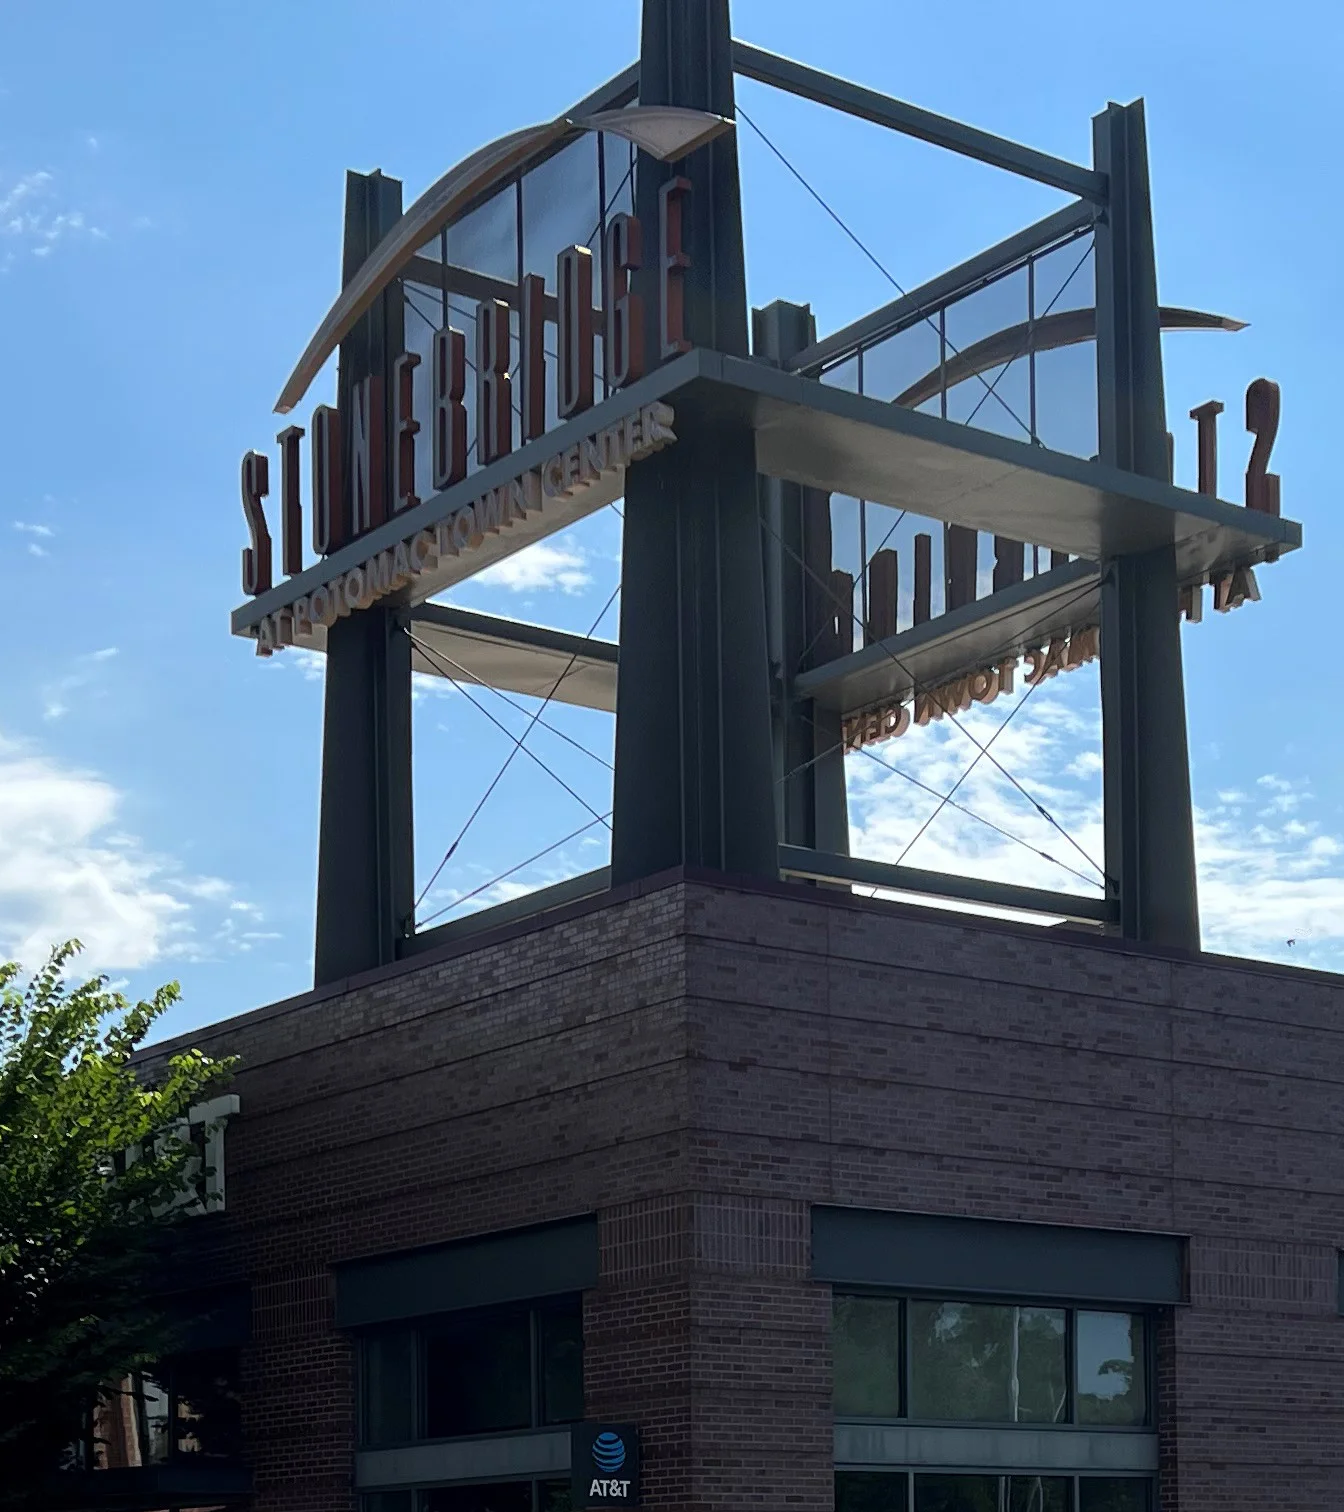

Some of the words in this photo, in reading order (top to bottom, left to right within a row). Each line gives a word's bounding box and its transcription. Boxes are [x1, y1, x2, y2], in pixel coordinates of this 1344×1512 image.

[240, 175, 692, 597] STONEBRIDGE
[256, 607, 295, 657] AT
[292, 529, 439, 636] POTOMAC
[436, 464, 543, 556] TOWN
[541, 401, 679, 500] CENTER
[589, 1479, 631, 1497] AT&T
